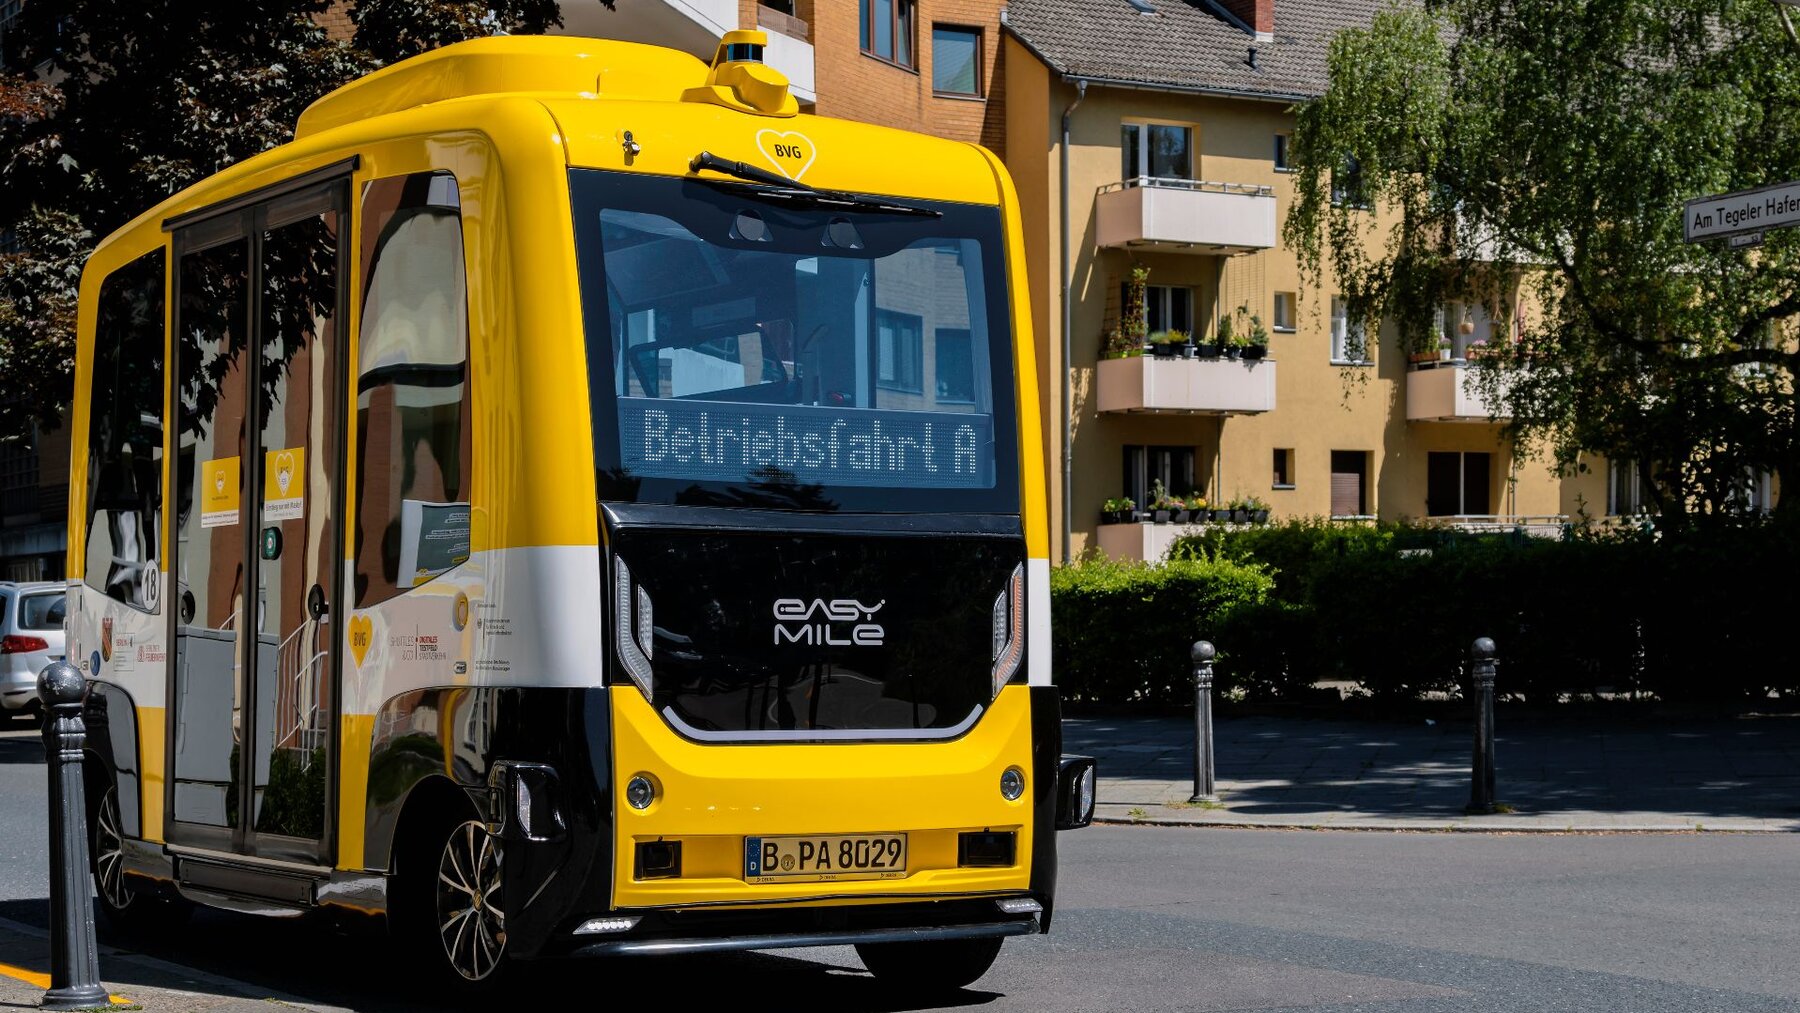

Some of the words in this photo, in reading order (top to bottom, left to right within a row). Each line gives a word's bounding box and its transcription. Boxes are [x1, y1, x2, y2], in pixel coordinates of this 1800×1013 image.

[774, 144, 802, 159] BVG
[1693, 212, 1713, 230] Am
[1716, 203, 1762, 227] Tegeler
[645, 409, 938, 473] Betriebsfahrt
[954, 423, 977, 474] A
[145, 569, 156, 601] 18
[353, 632, 366, 646] BVG
[750, 861, 757, 871] D
[762, 842, 779, 872] B
[798, 840, 832, 870] PA
[838, 838, 902, 869] 8029
